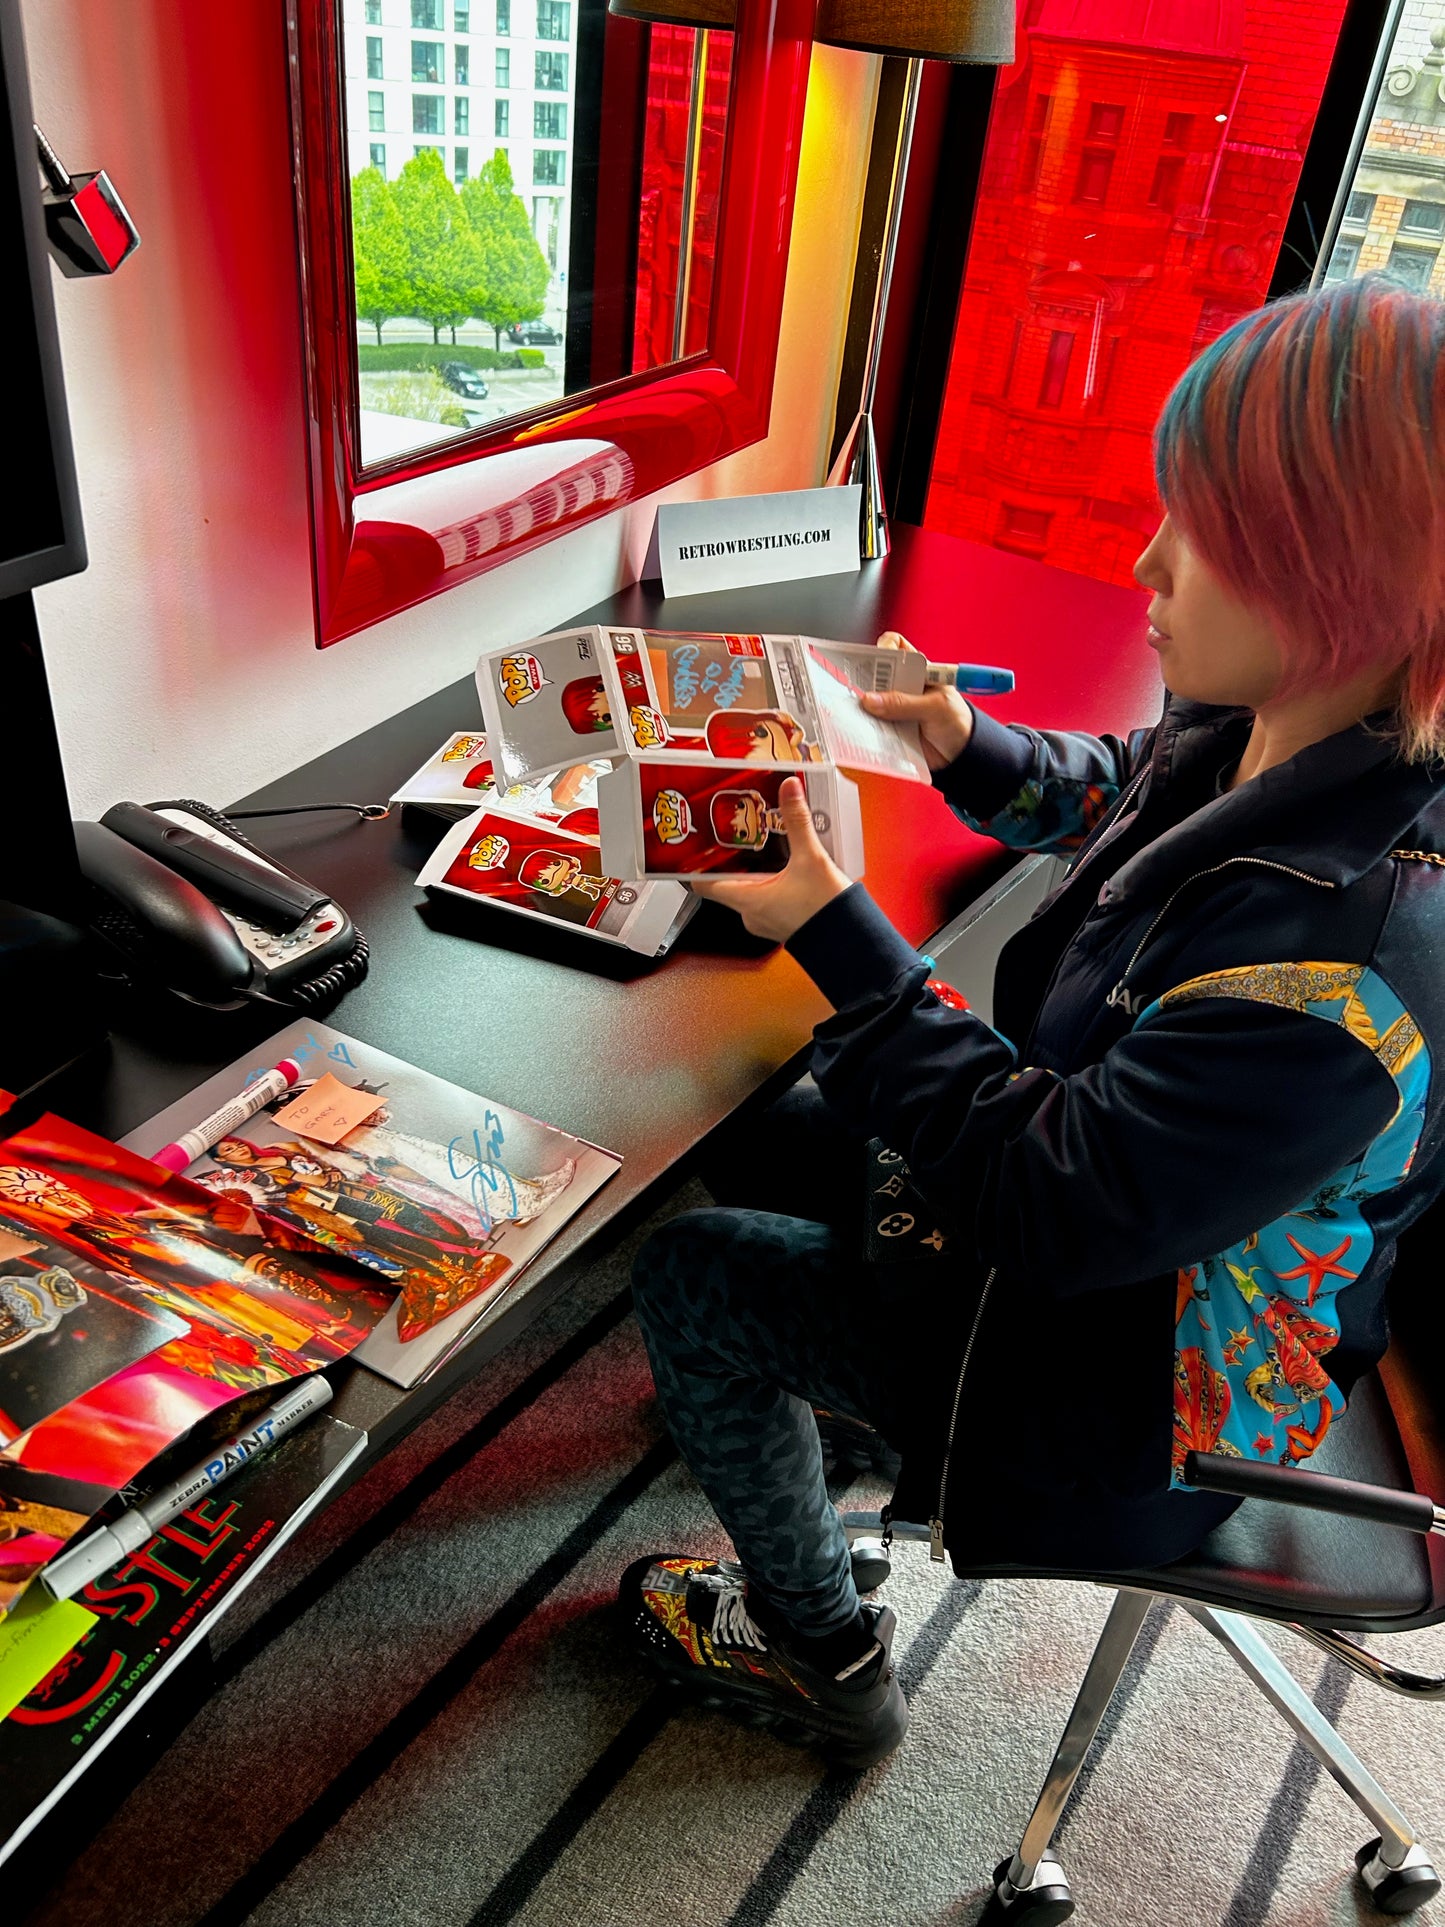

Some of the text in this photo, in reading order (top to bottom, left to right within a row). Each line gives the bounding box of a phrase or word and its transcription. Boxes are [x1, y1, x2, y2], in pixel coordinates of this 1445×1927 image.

[678, 528, 832, 561] RETROWRESTLING.COM
[614, 635, 634, 653] 56
[499, 657, 536, 709] POP!
[630, 705, 662, 751] POP!
[442, 736, 479, 763] POP!
[657, 791, 682, 843] POP!
[469, 834, 503, 867] POP!
[603, 883, 618, 899] ASUKA
[618, 890, 633, 902] 56
[288, 1105, 310, 1121] TO
[205, 1169, 258, 1185] アスカ
[169, 1476, 210, 1508] ZEBRA
[277, 1398, 314, 1430] MARKER
[84, 1690, 122, 1733] MEDI
[120, 1652, 157, 1690] 2022
[169, 1552, 247, 1637] SEPTEMBER
[244, 1518, 276, 1552] 2022
